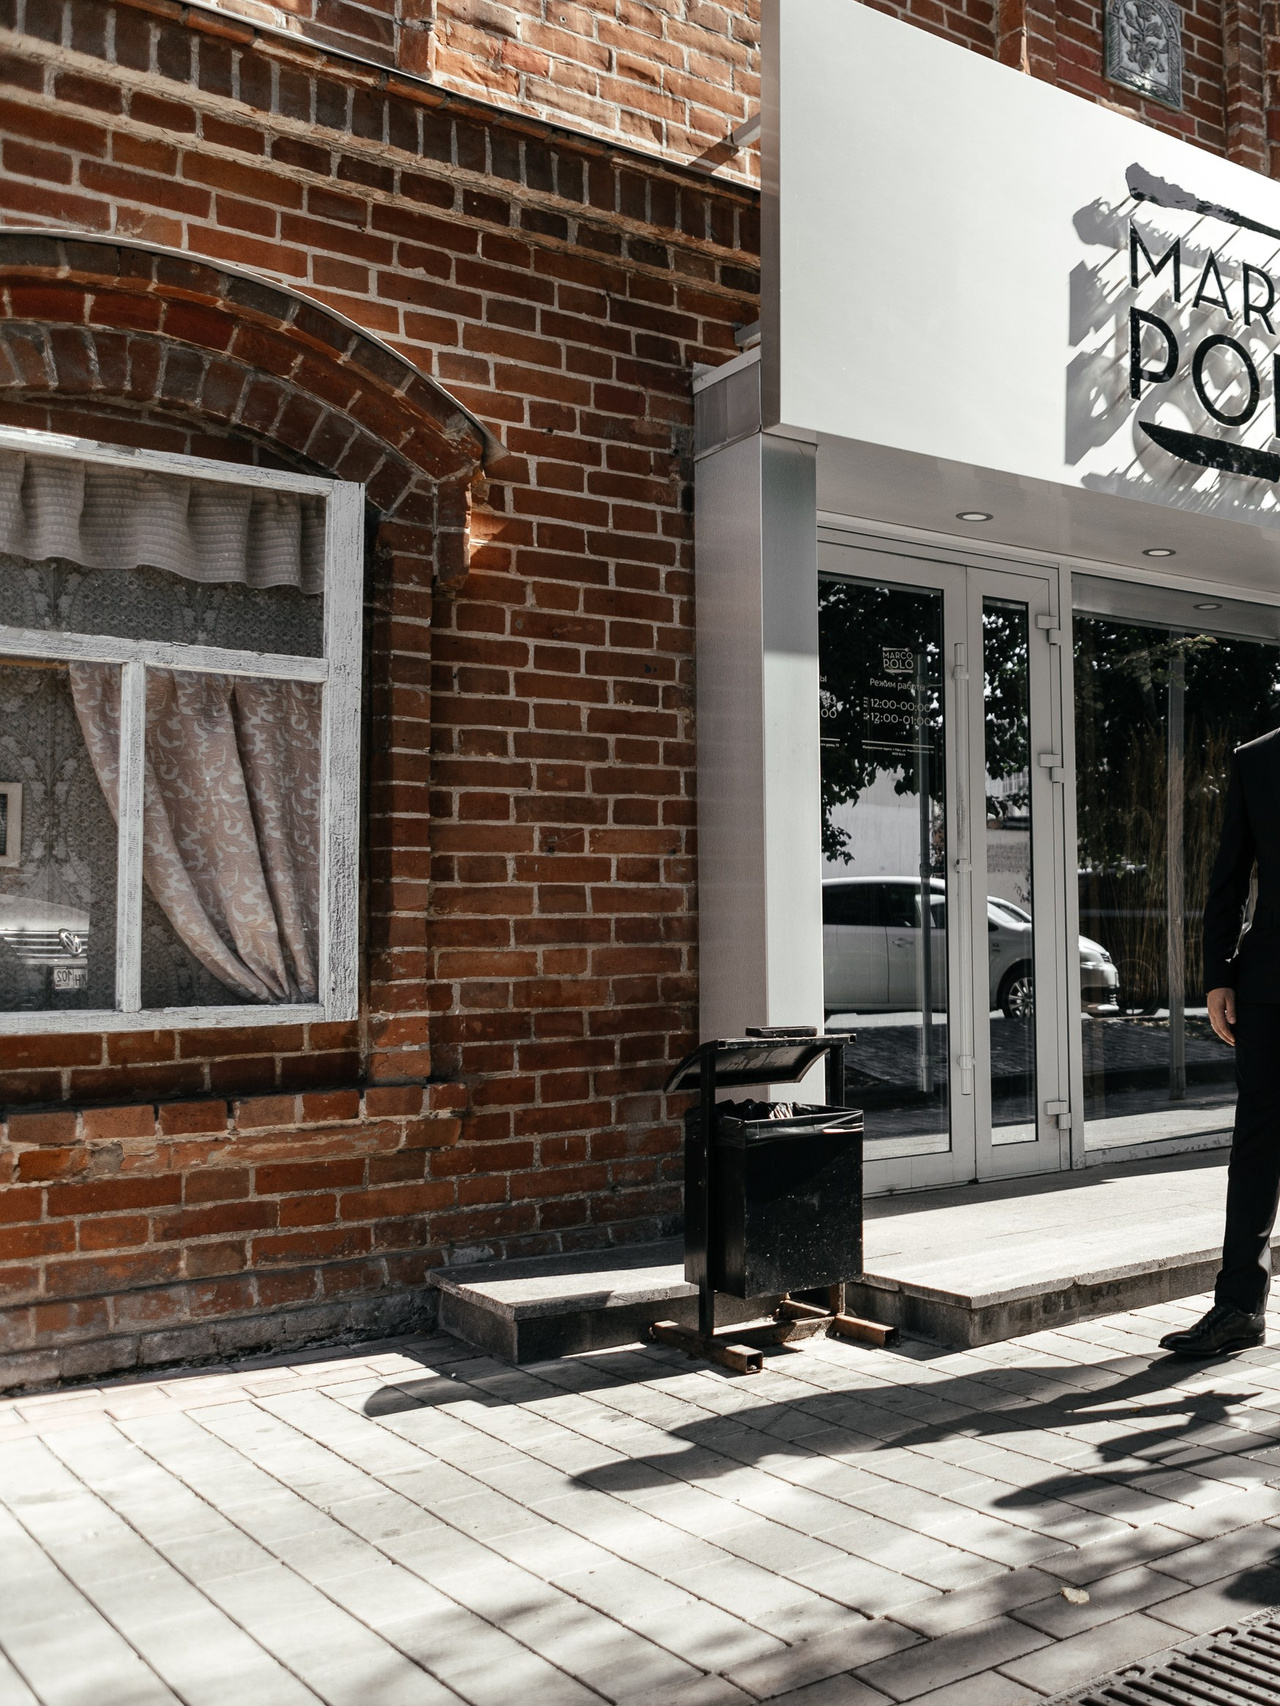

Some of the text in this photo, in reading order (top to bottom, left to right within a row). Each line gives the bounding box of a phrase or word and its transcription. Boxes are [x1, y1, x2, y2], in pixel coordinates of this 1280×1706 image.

[882, 651, 914, 660] MARCO
[883, 658, 914, 669] POLO
[869, 677, 926, 692] Режим работы
[870, 698, 931, 713] 12:00-00:00
[870, 712, 931, 726] 12:00-01:00
